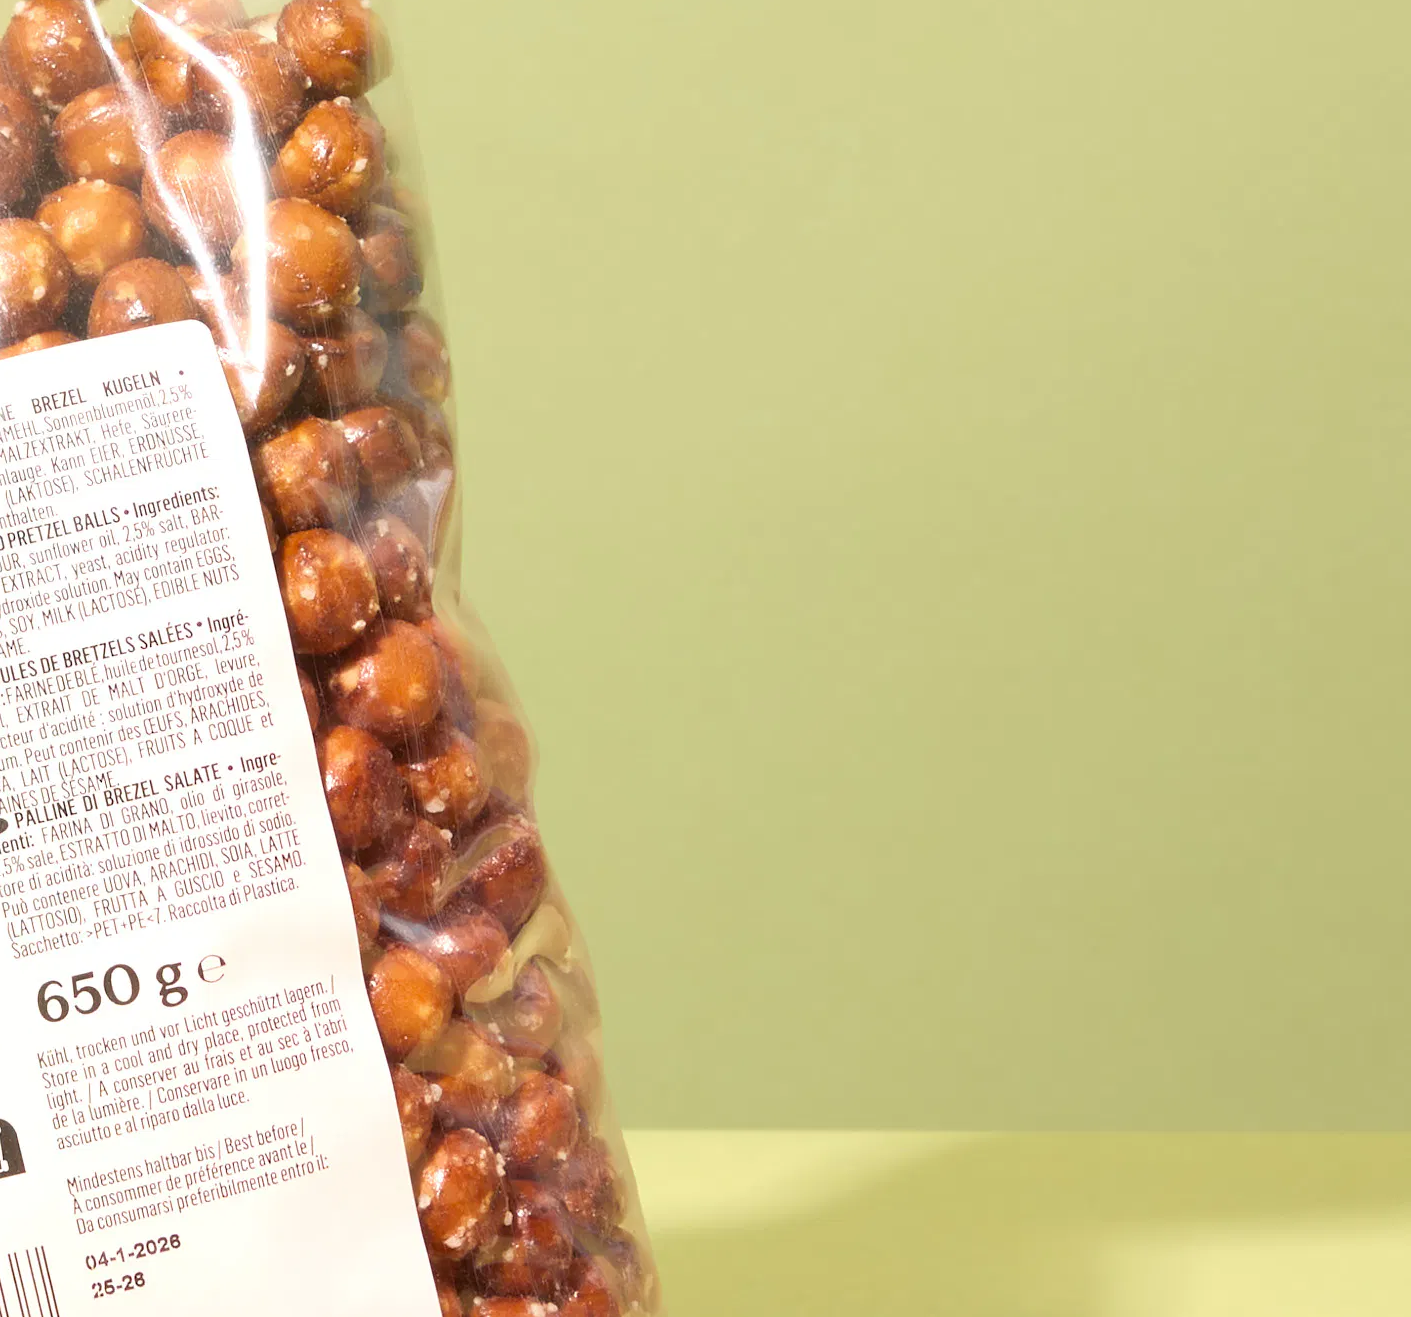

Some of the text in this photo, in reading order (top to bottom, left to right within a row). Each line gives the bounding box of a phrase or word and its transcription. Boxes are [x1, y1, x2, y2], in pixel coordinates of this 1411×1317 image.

[31, 370, 161, 415] BREZEL KUGELN
[6, 519, 72, 549] PRETZEL
[72, 506, 121, 533] BALLS
[132, 486, 220, 519] Ingredients:
[39, 654, 61, 674] DE
[62, 636, 136, 669] BRETZELS
[137, 621, 194, 650] SALÉES
[206, 608, 249, 634] Ingré-
[14, 798, 78, 829] PALLINE
[82, 793, 99, 812] DI
[103, 779, 160, 807] BREZEL
[163, 762, 222, 792] SALATE
[240, 752, 281, 774] Ingre-
[36, 981, 328, 1069] Kühl, trocken und vor Licht geschützt lagern.
[37, 961, 189, 1023] 650 g
[41, 998, 341, 1089] Store in a cool and dry place, protected from
[56, 1091, 250, 1151] asciutto e al riparo dalla luce.
[66, 1123, 298, 1197] Mindestens haltbar bis Best before
[69, 1139, 308, 1215] À consommer de préférence avant le
[75, 1153, 330, 1235] Da consumarsi preferibilmente entro il:
